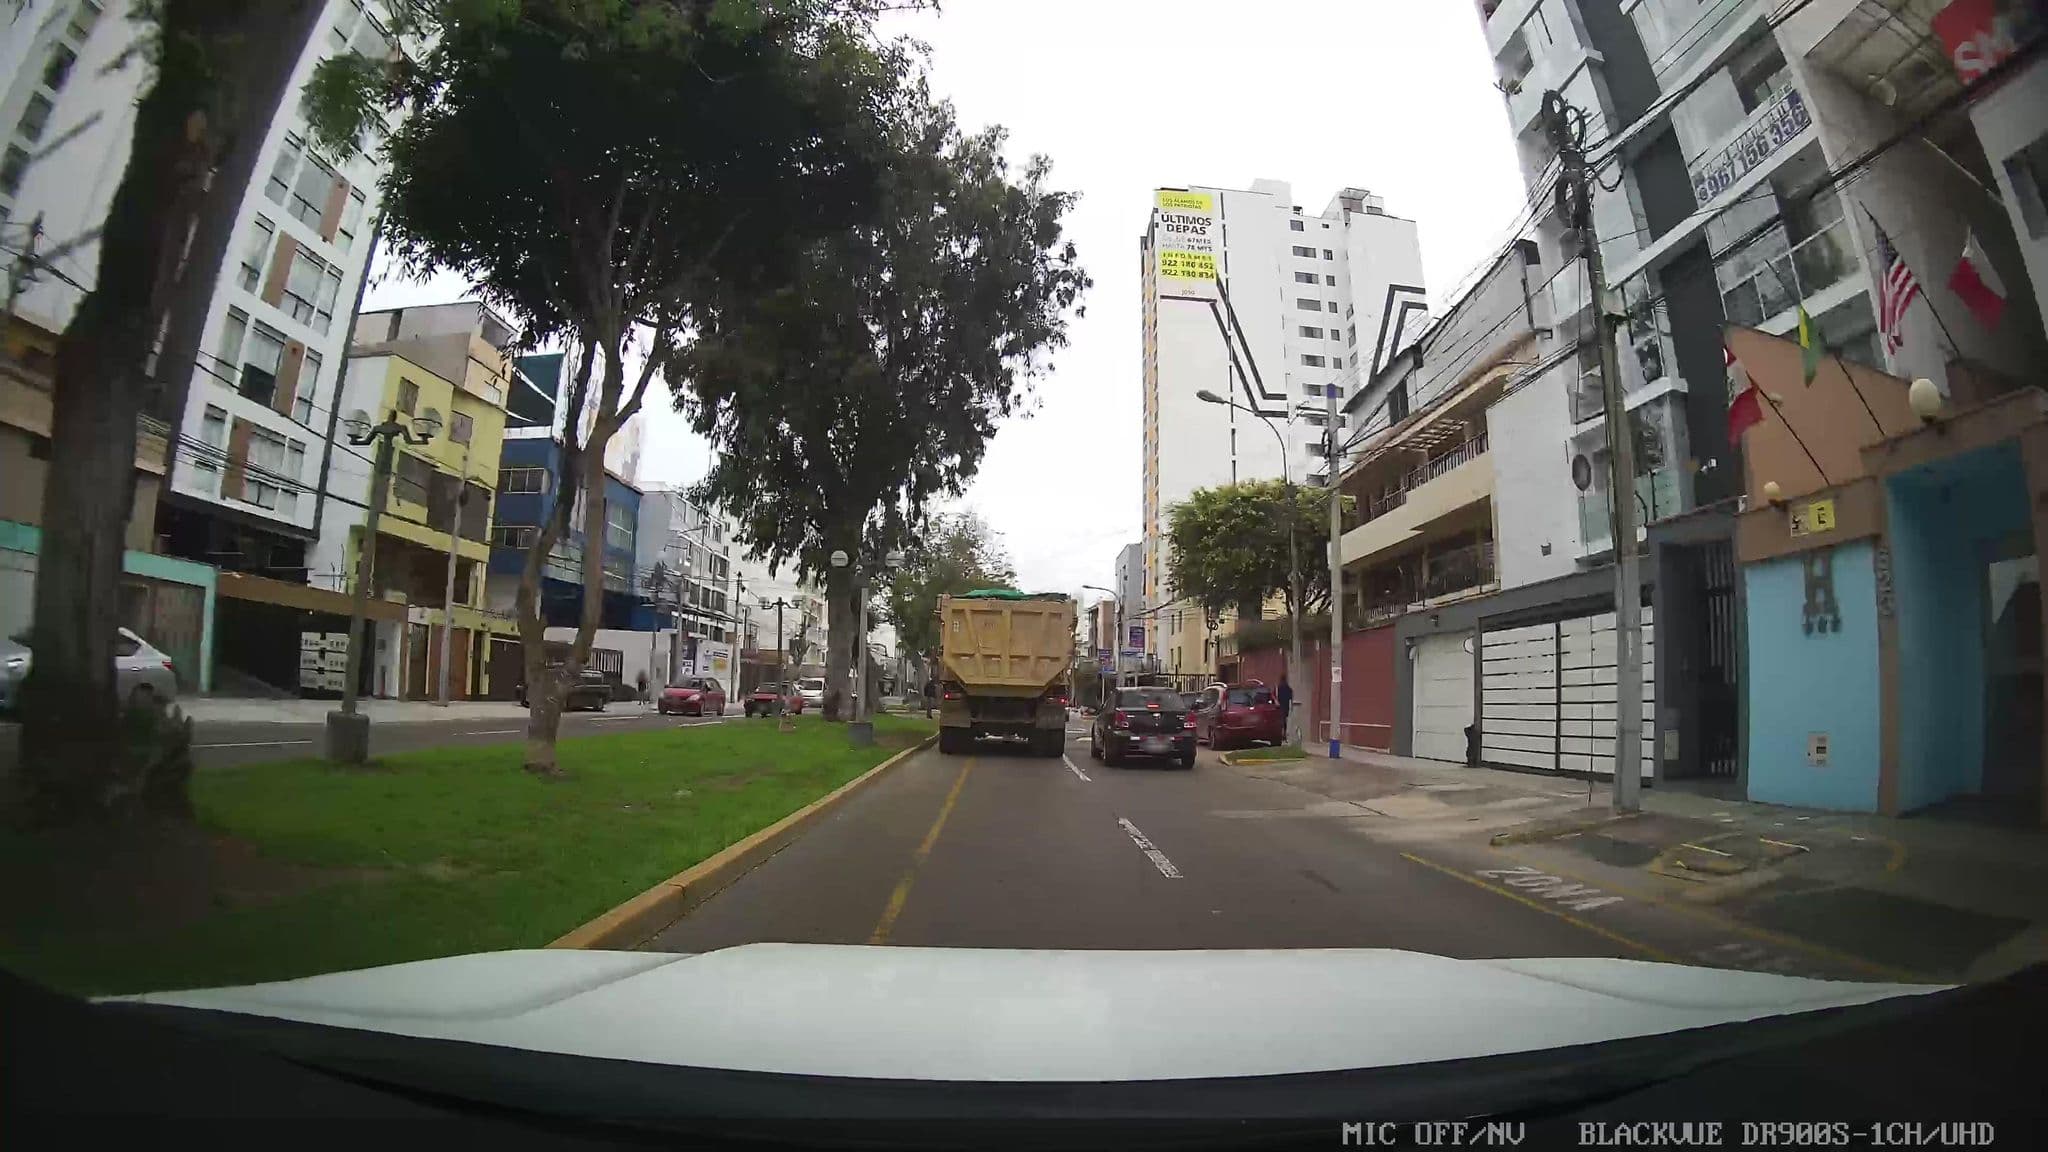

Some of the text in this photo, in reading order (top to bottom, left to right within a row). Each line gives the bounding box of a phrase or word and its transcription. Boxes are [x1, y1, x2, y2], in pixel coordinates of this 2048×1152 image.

[1735, 134, 1770, 172] 156
[1769, 104, 1806, 145] 356
[1161, 211, 1212, 226] ÚLTIMOS
[1166, 223, 1206, 235] DEPAS
[1473, 866, 1625, 911] ZONA
